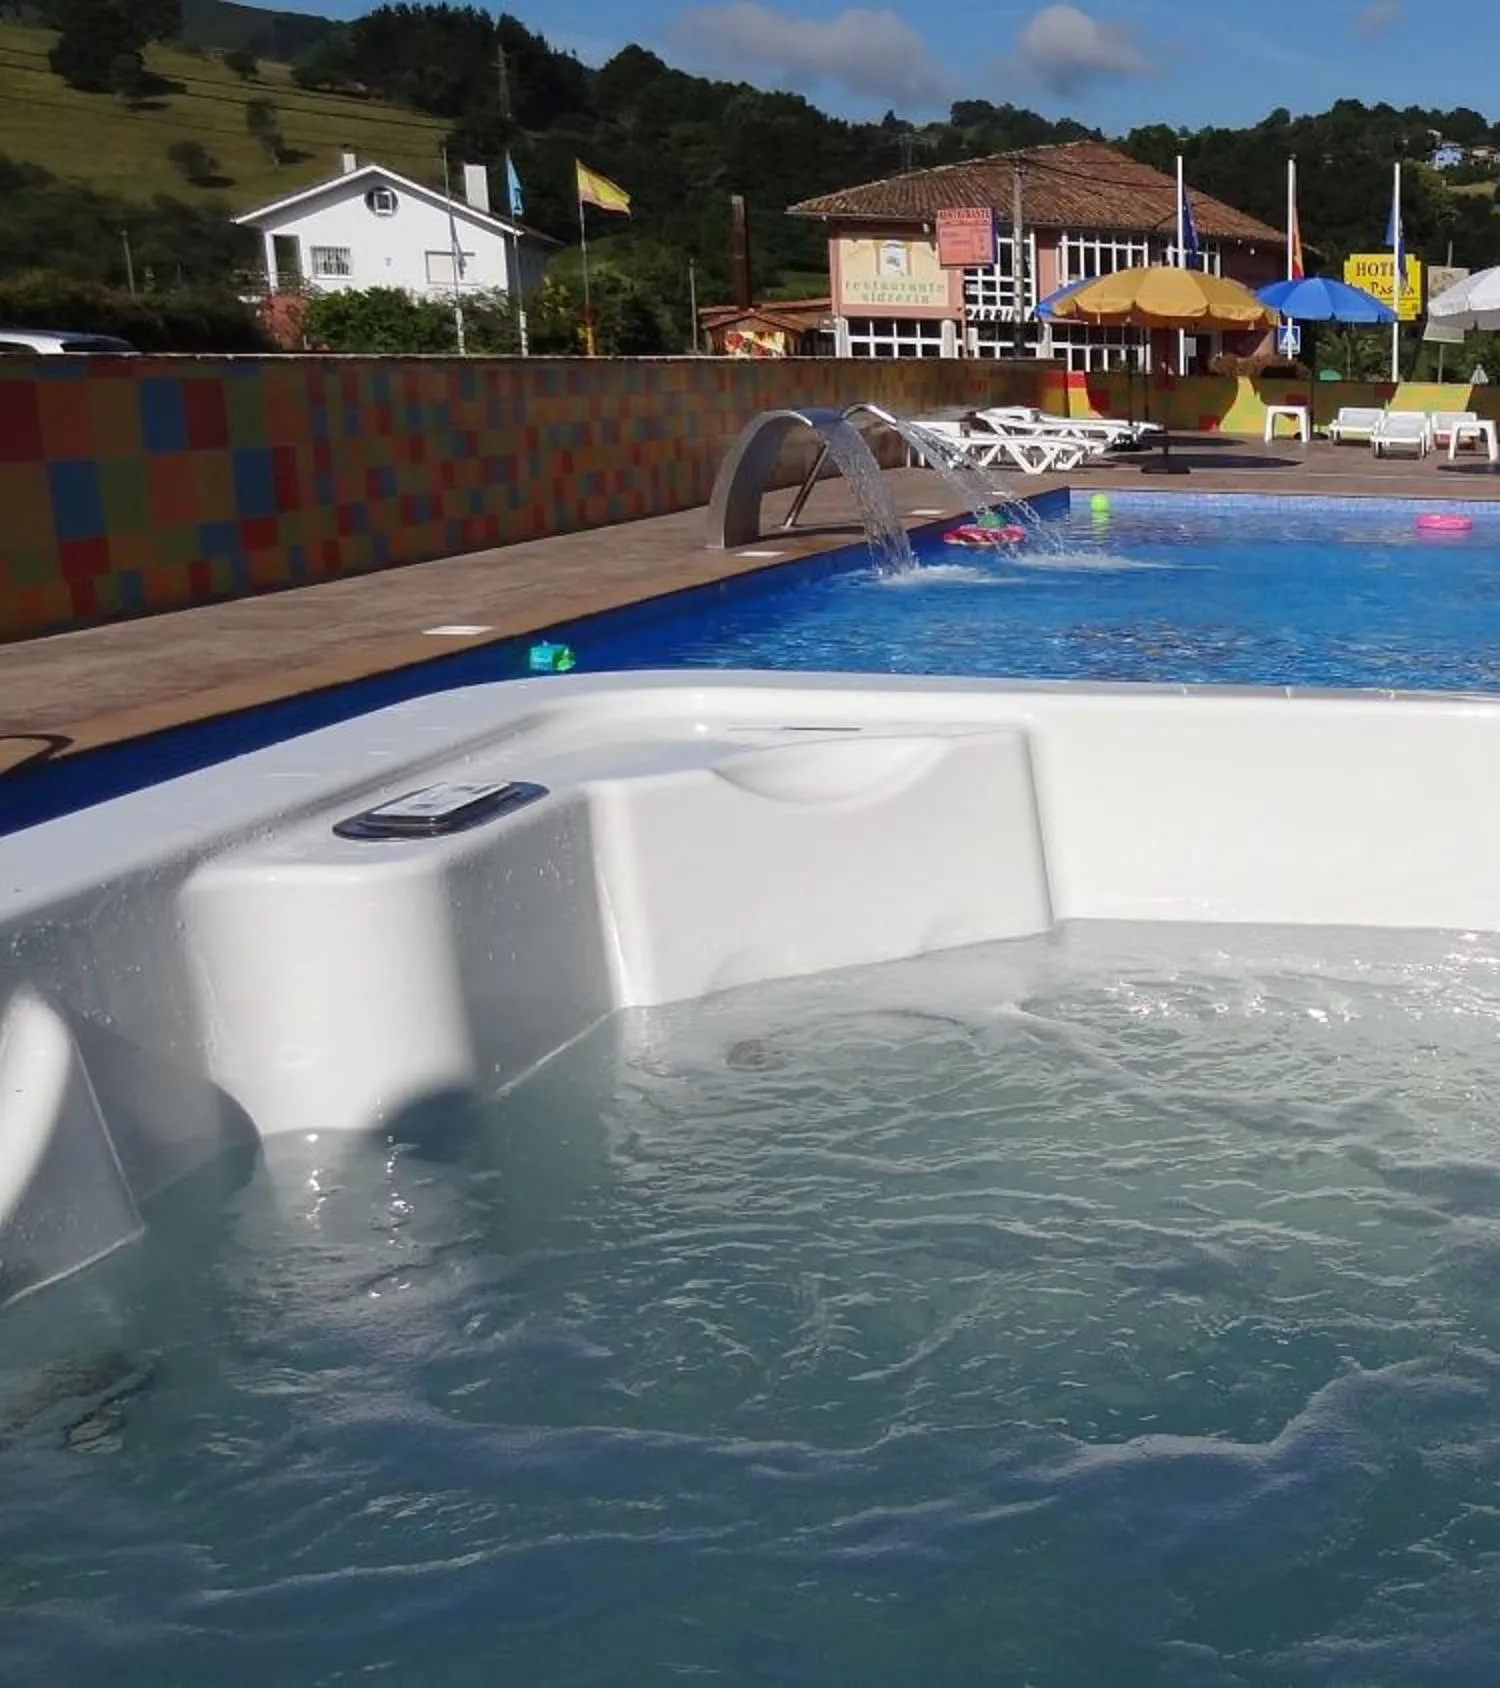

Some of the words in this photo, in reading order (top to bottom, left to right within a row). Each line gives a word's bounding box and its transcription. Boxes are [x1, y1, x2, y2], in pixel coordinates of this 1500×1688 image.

[1356, 262, 1407, 276] HOT
[845, 280, 945, 293] restaurante
[965, 308, 1036, 321] PARRIA
